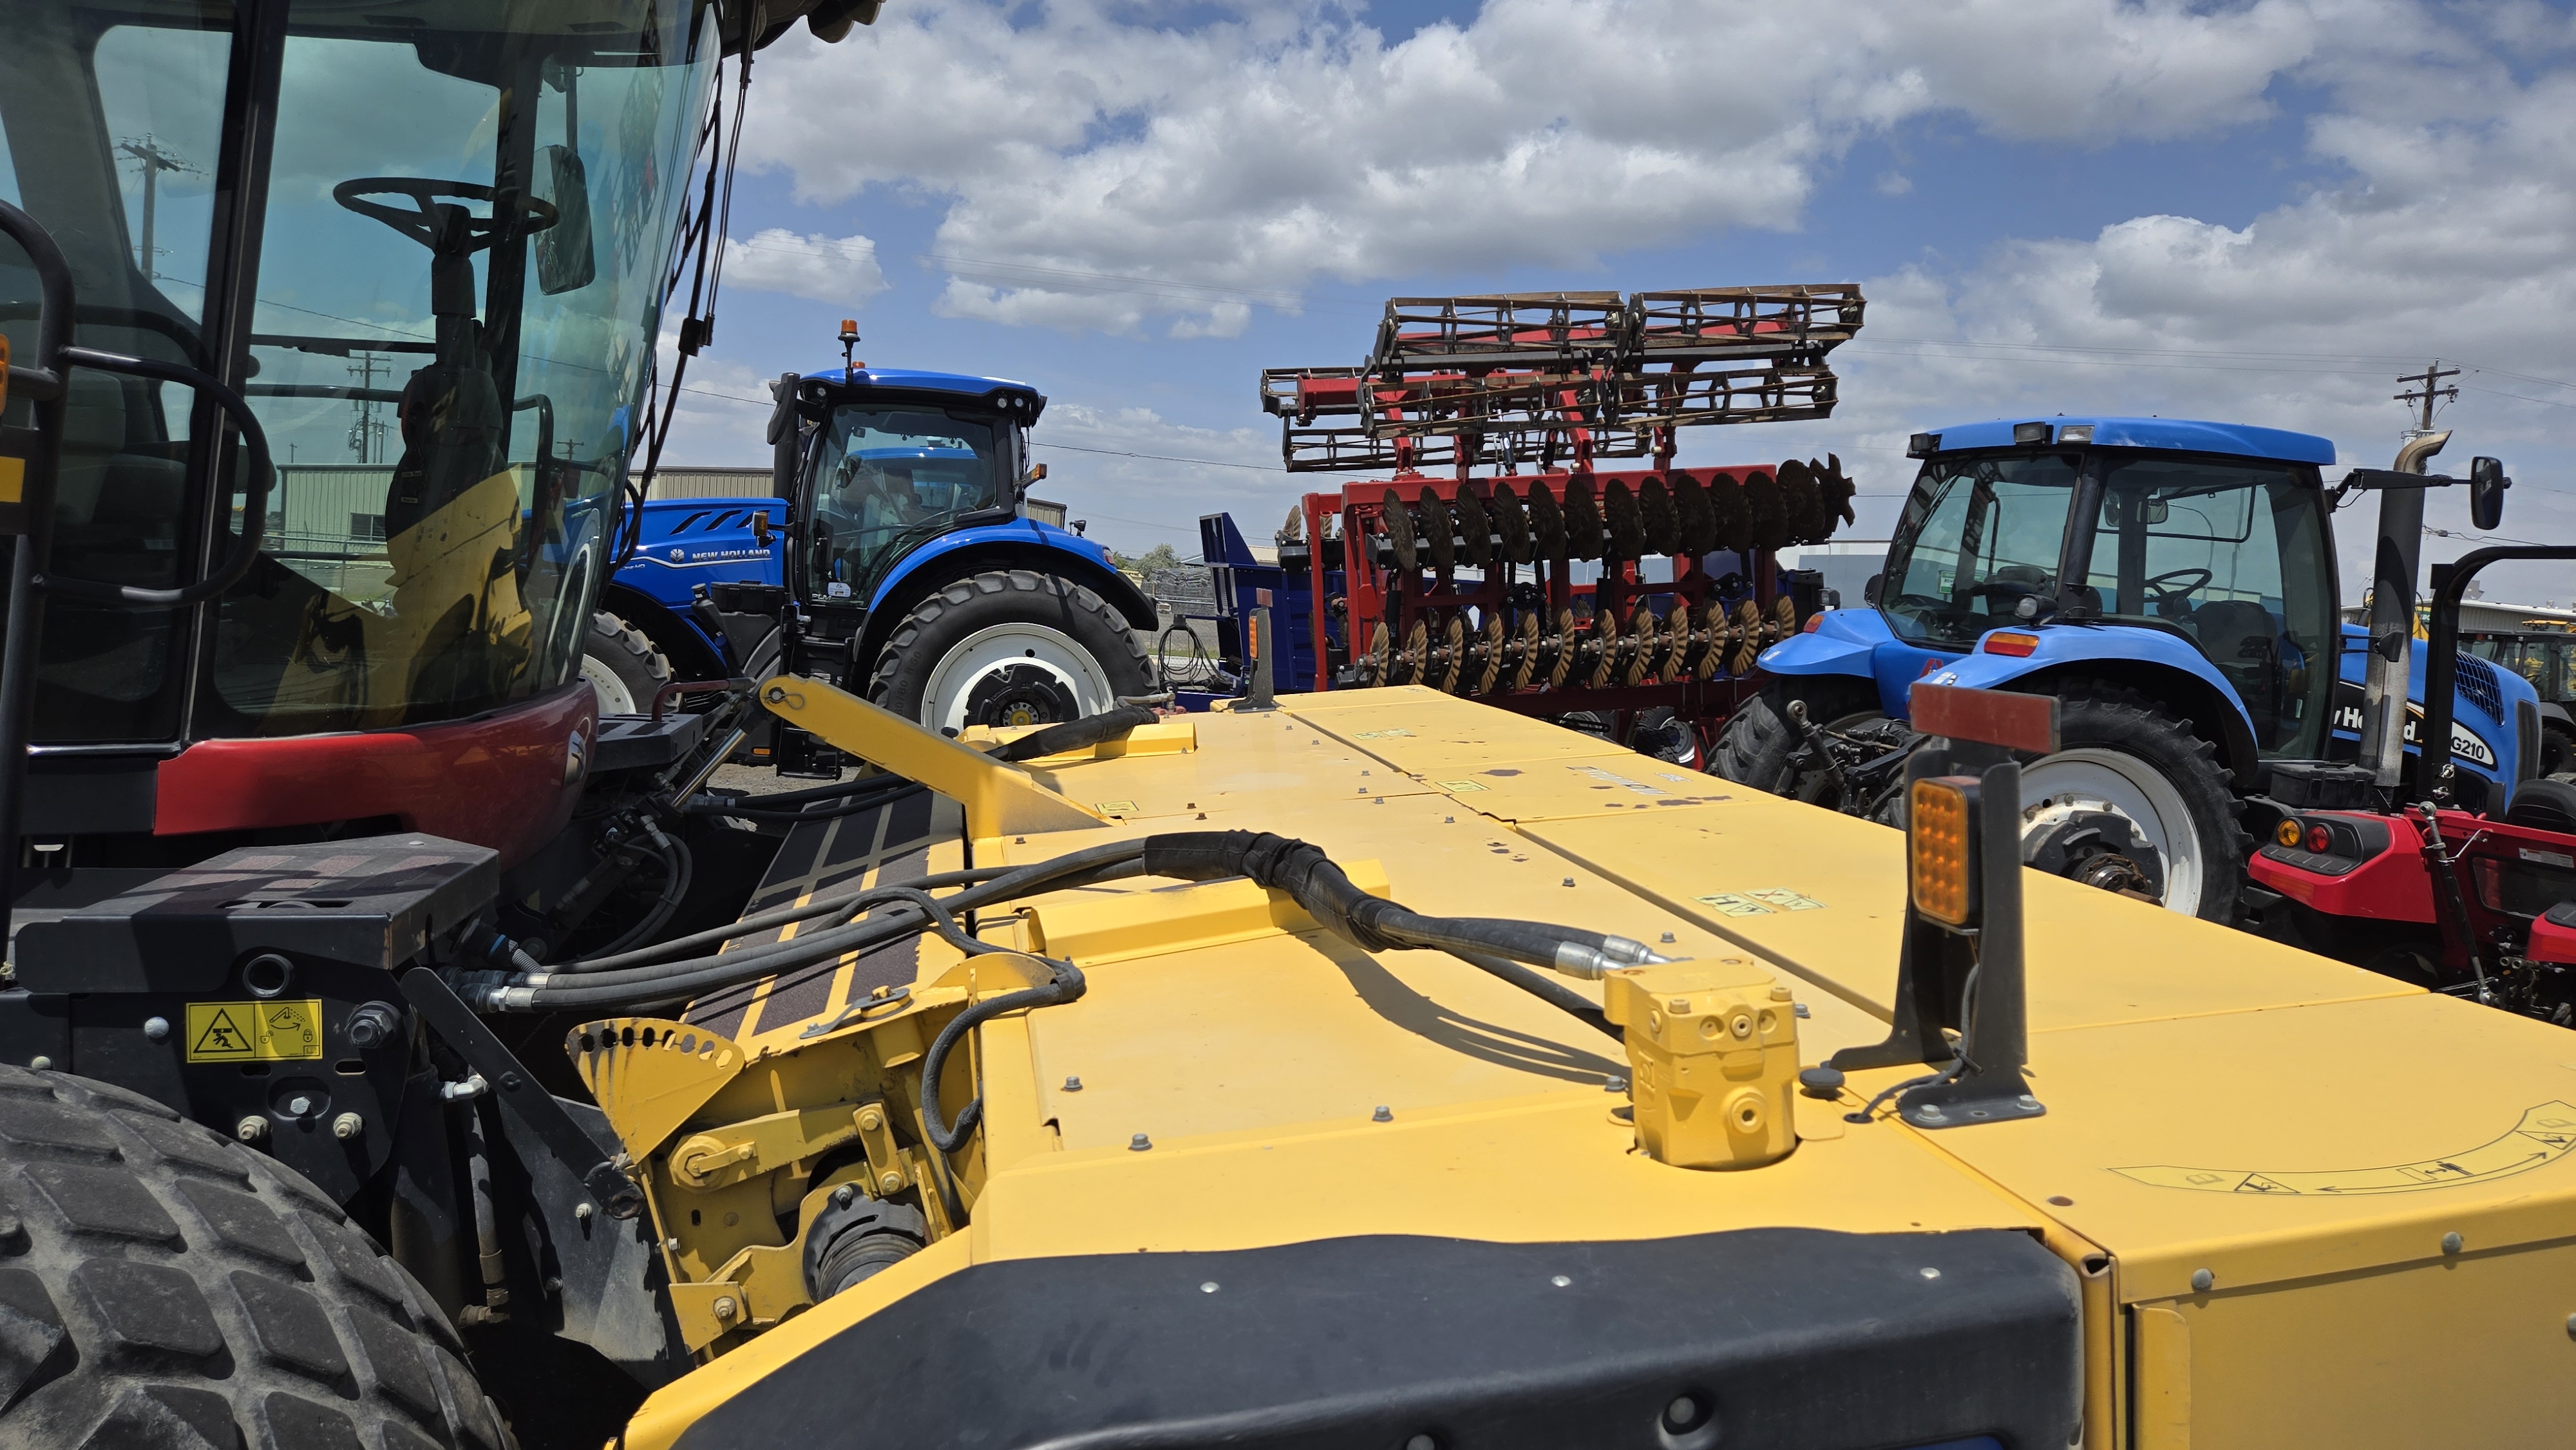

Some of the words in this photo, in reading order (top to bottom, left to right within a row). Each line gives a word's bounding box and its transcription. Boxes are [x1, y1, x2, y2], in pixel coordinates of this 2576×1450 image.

[692, 552, 719, 561] NEW
[721, 549, 770, 560] HOLLAND
[2451, 736, 2485, 760] G210
